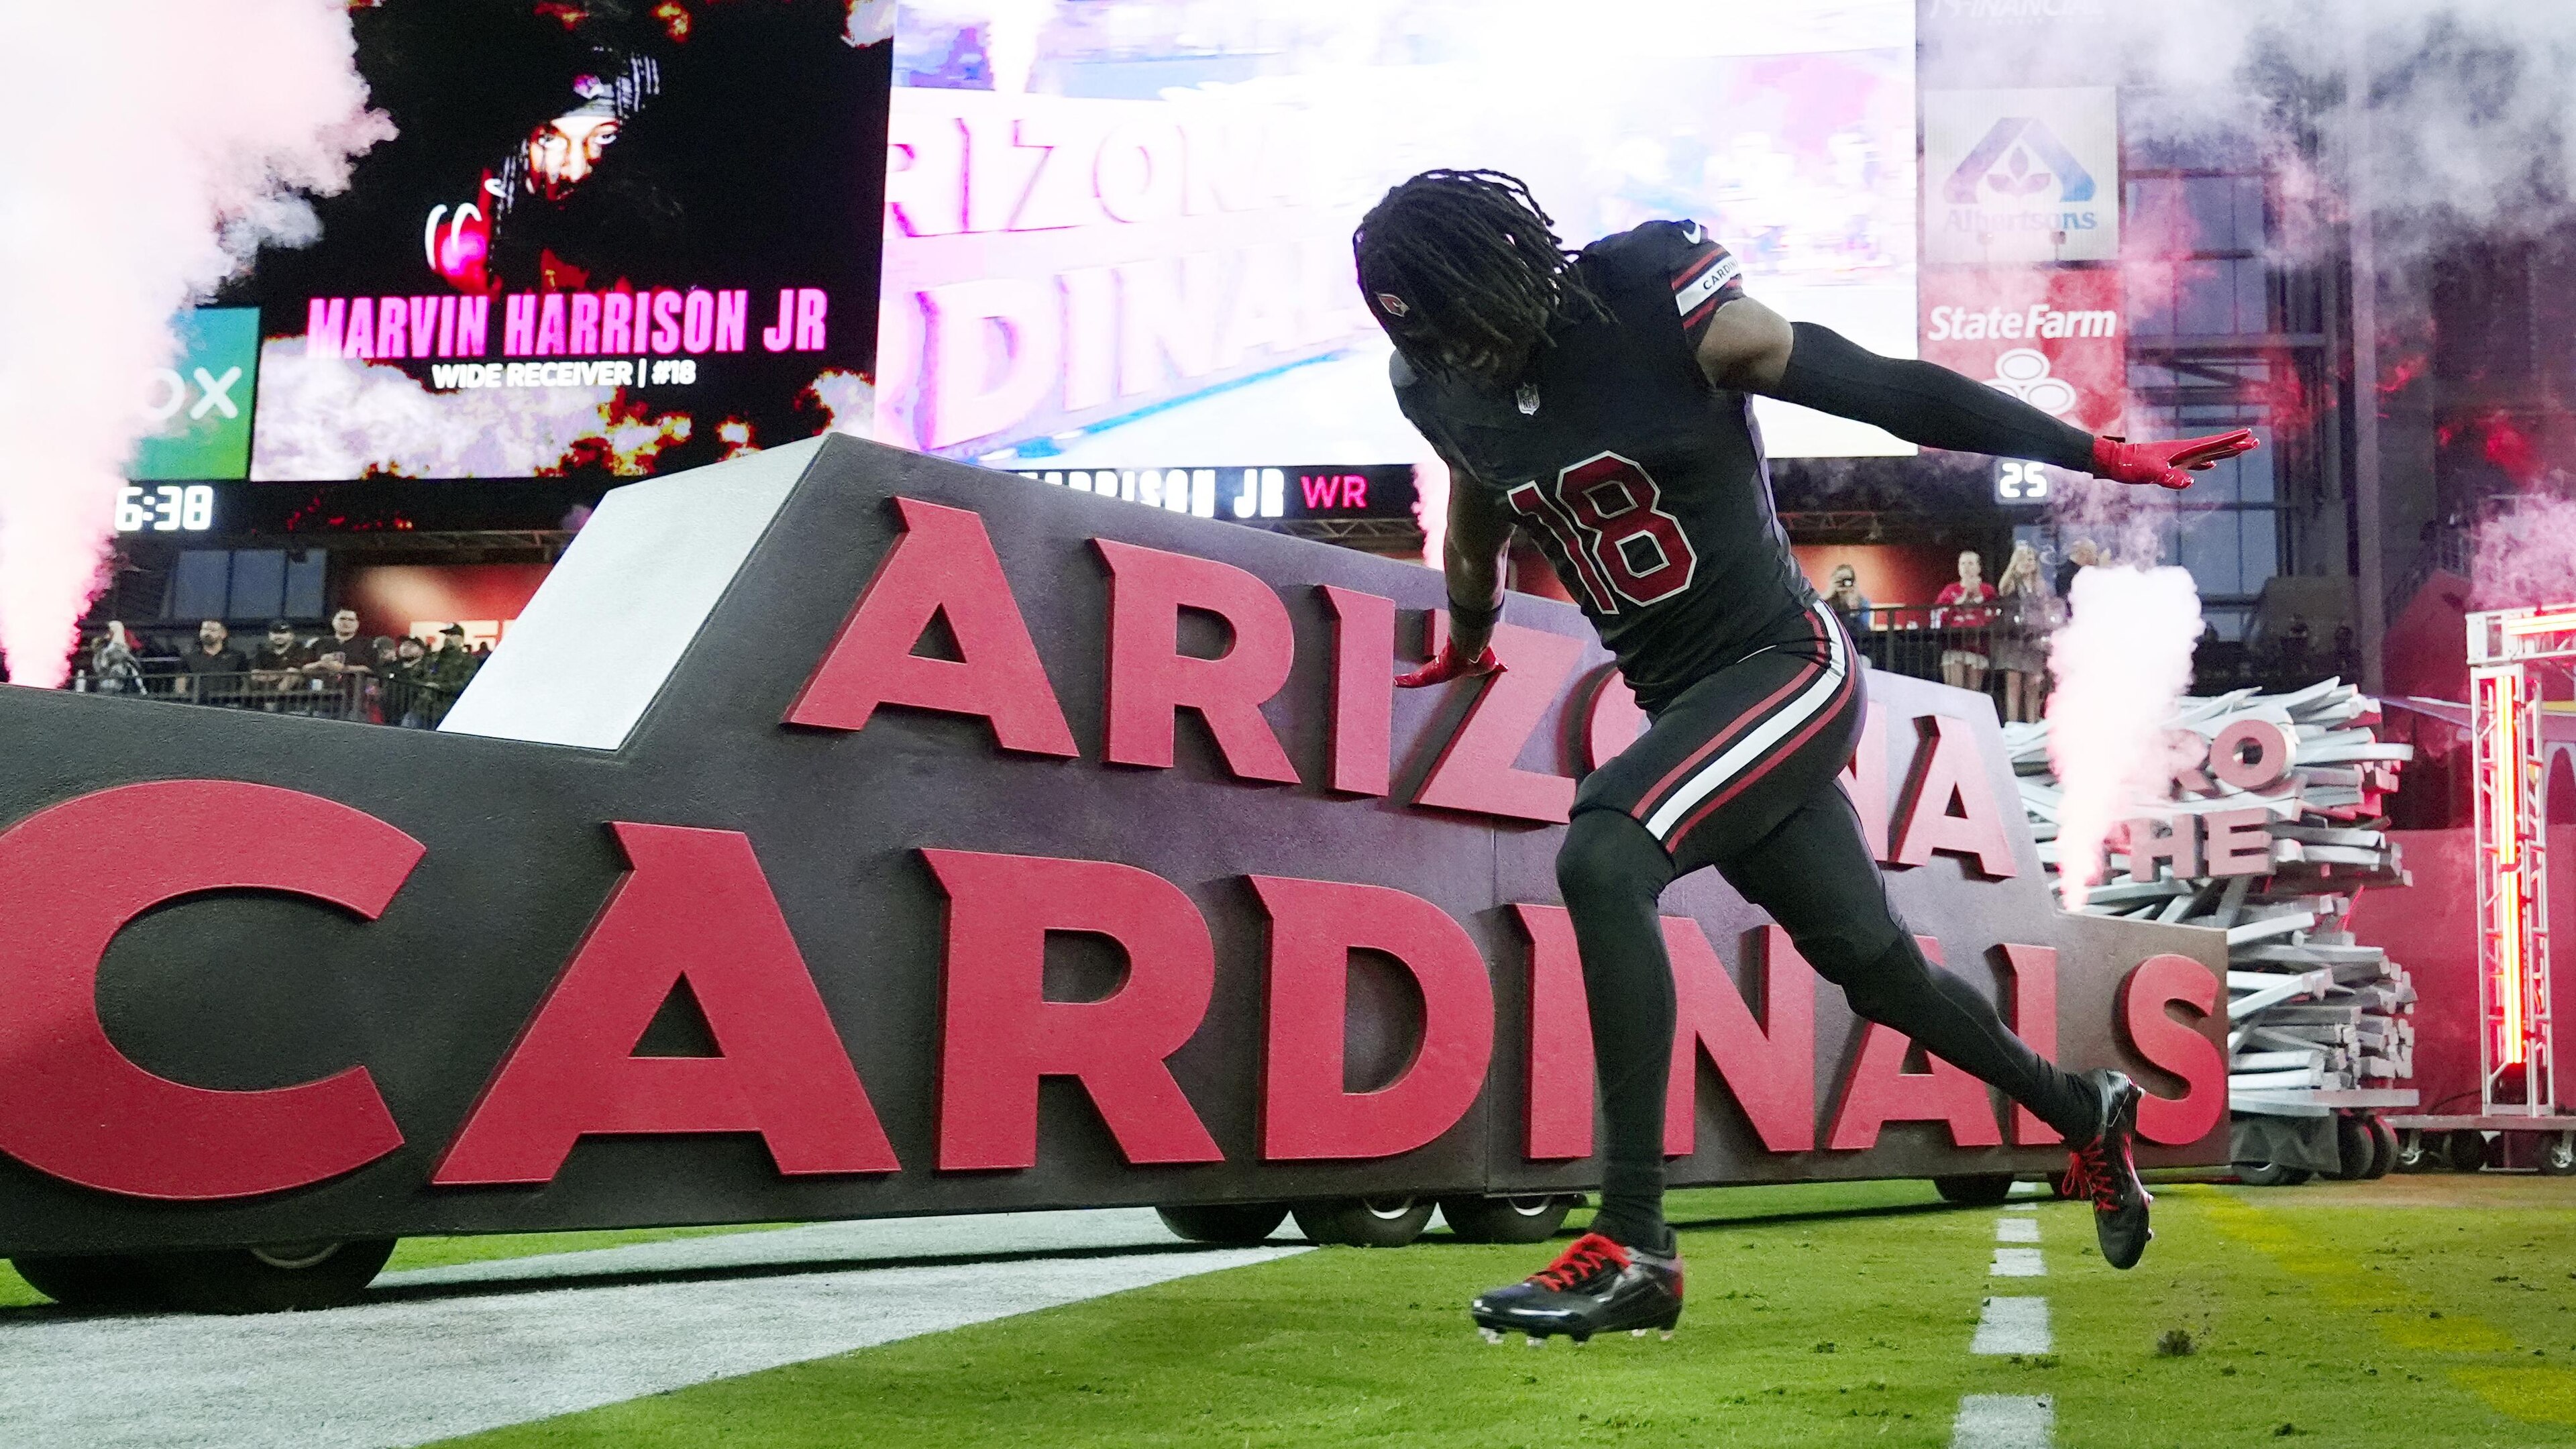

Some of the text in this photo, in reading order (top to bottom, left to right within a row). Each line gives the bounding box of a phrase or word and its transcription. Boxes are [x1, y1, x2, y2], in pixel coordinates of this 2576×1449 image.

[307, 288, 827, 359] MARVIN HARRISON JR
[431, 363, 503, 389] WIDE
[506, 360, 633, 388] RECEIVER
[651, 360, 697, 385] #18
[1234, 468, 1285, 518] JR
[1299, 474, 1368, 510] WR
[2000, 462, 2047, 498] 25
[114, 485, 213, 531] 6:38
[1507, 450, 1697, 614] 18
[785, 496, 2019, 878] ARIZA
